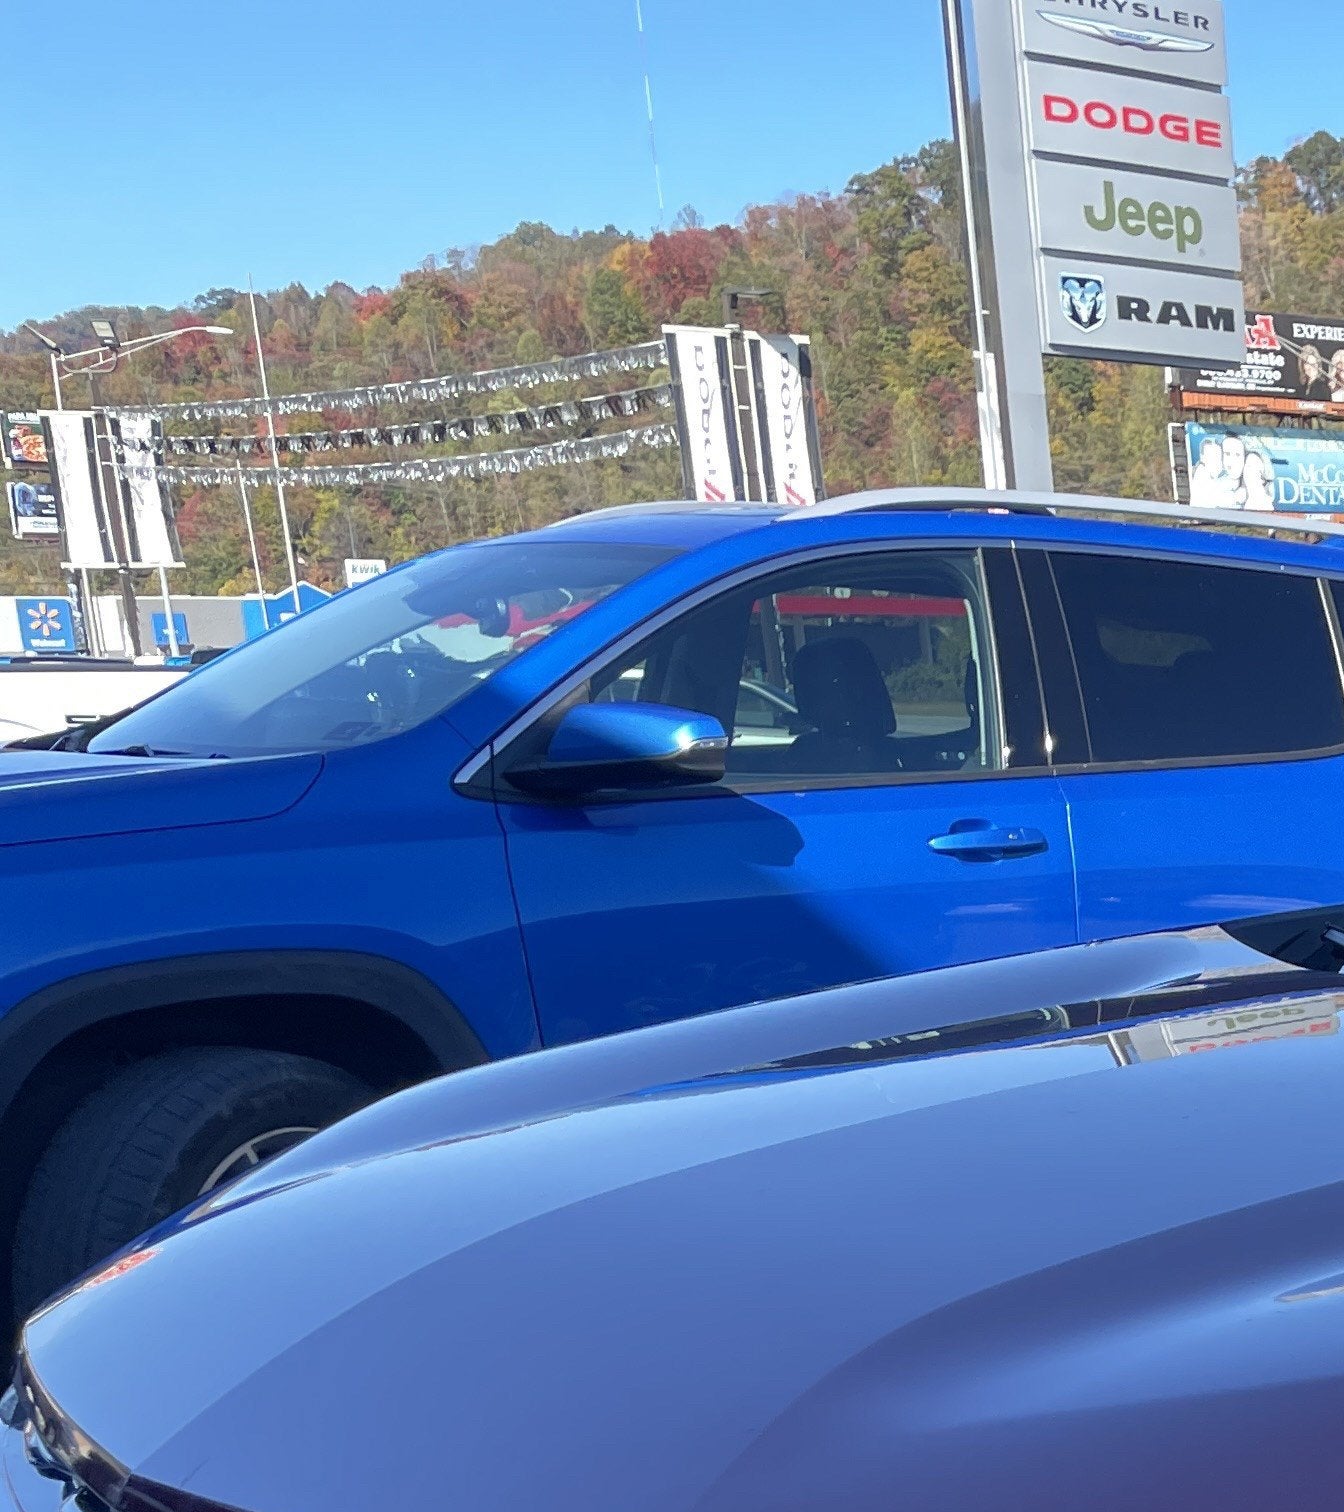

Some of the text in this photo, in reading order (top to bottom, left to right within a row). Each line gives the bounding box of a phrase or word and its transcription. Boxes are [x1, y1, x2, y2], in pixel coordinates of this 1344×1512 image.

[1043, 0, 1210, 31] RYSLER
[1043, 94, 1222, 149] DODGE
[1083, 180, 1203, 253] Jeep
[1116, 294, 1235, 332] RAM
